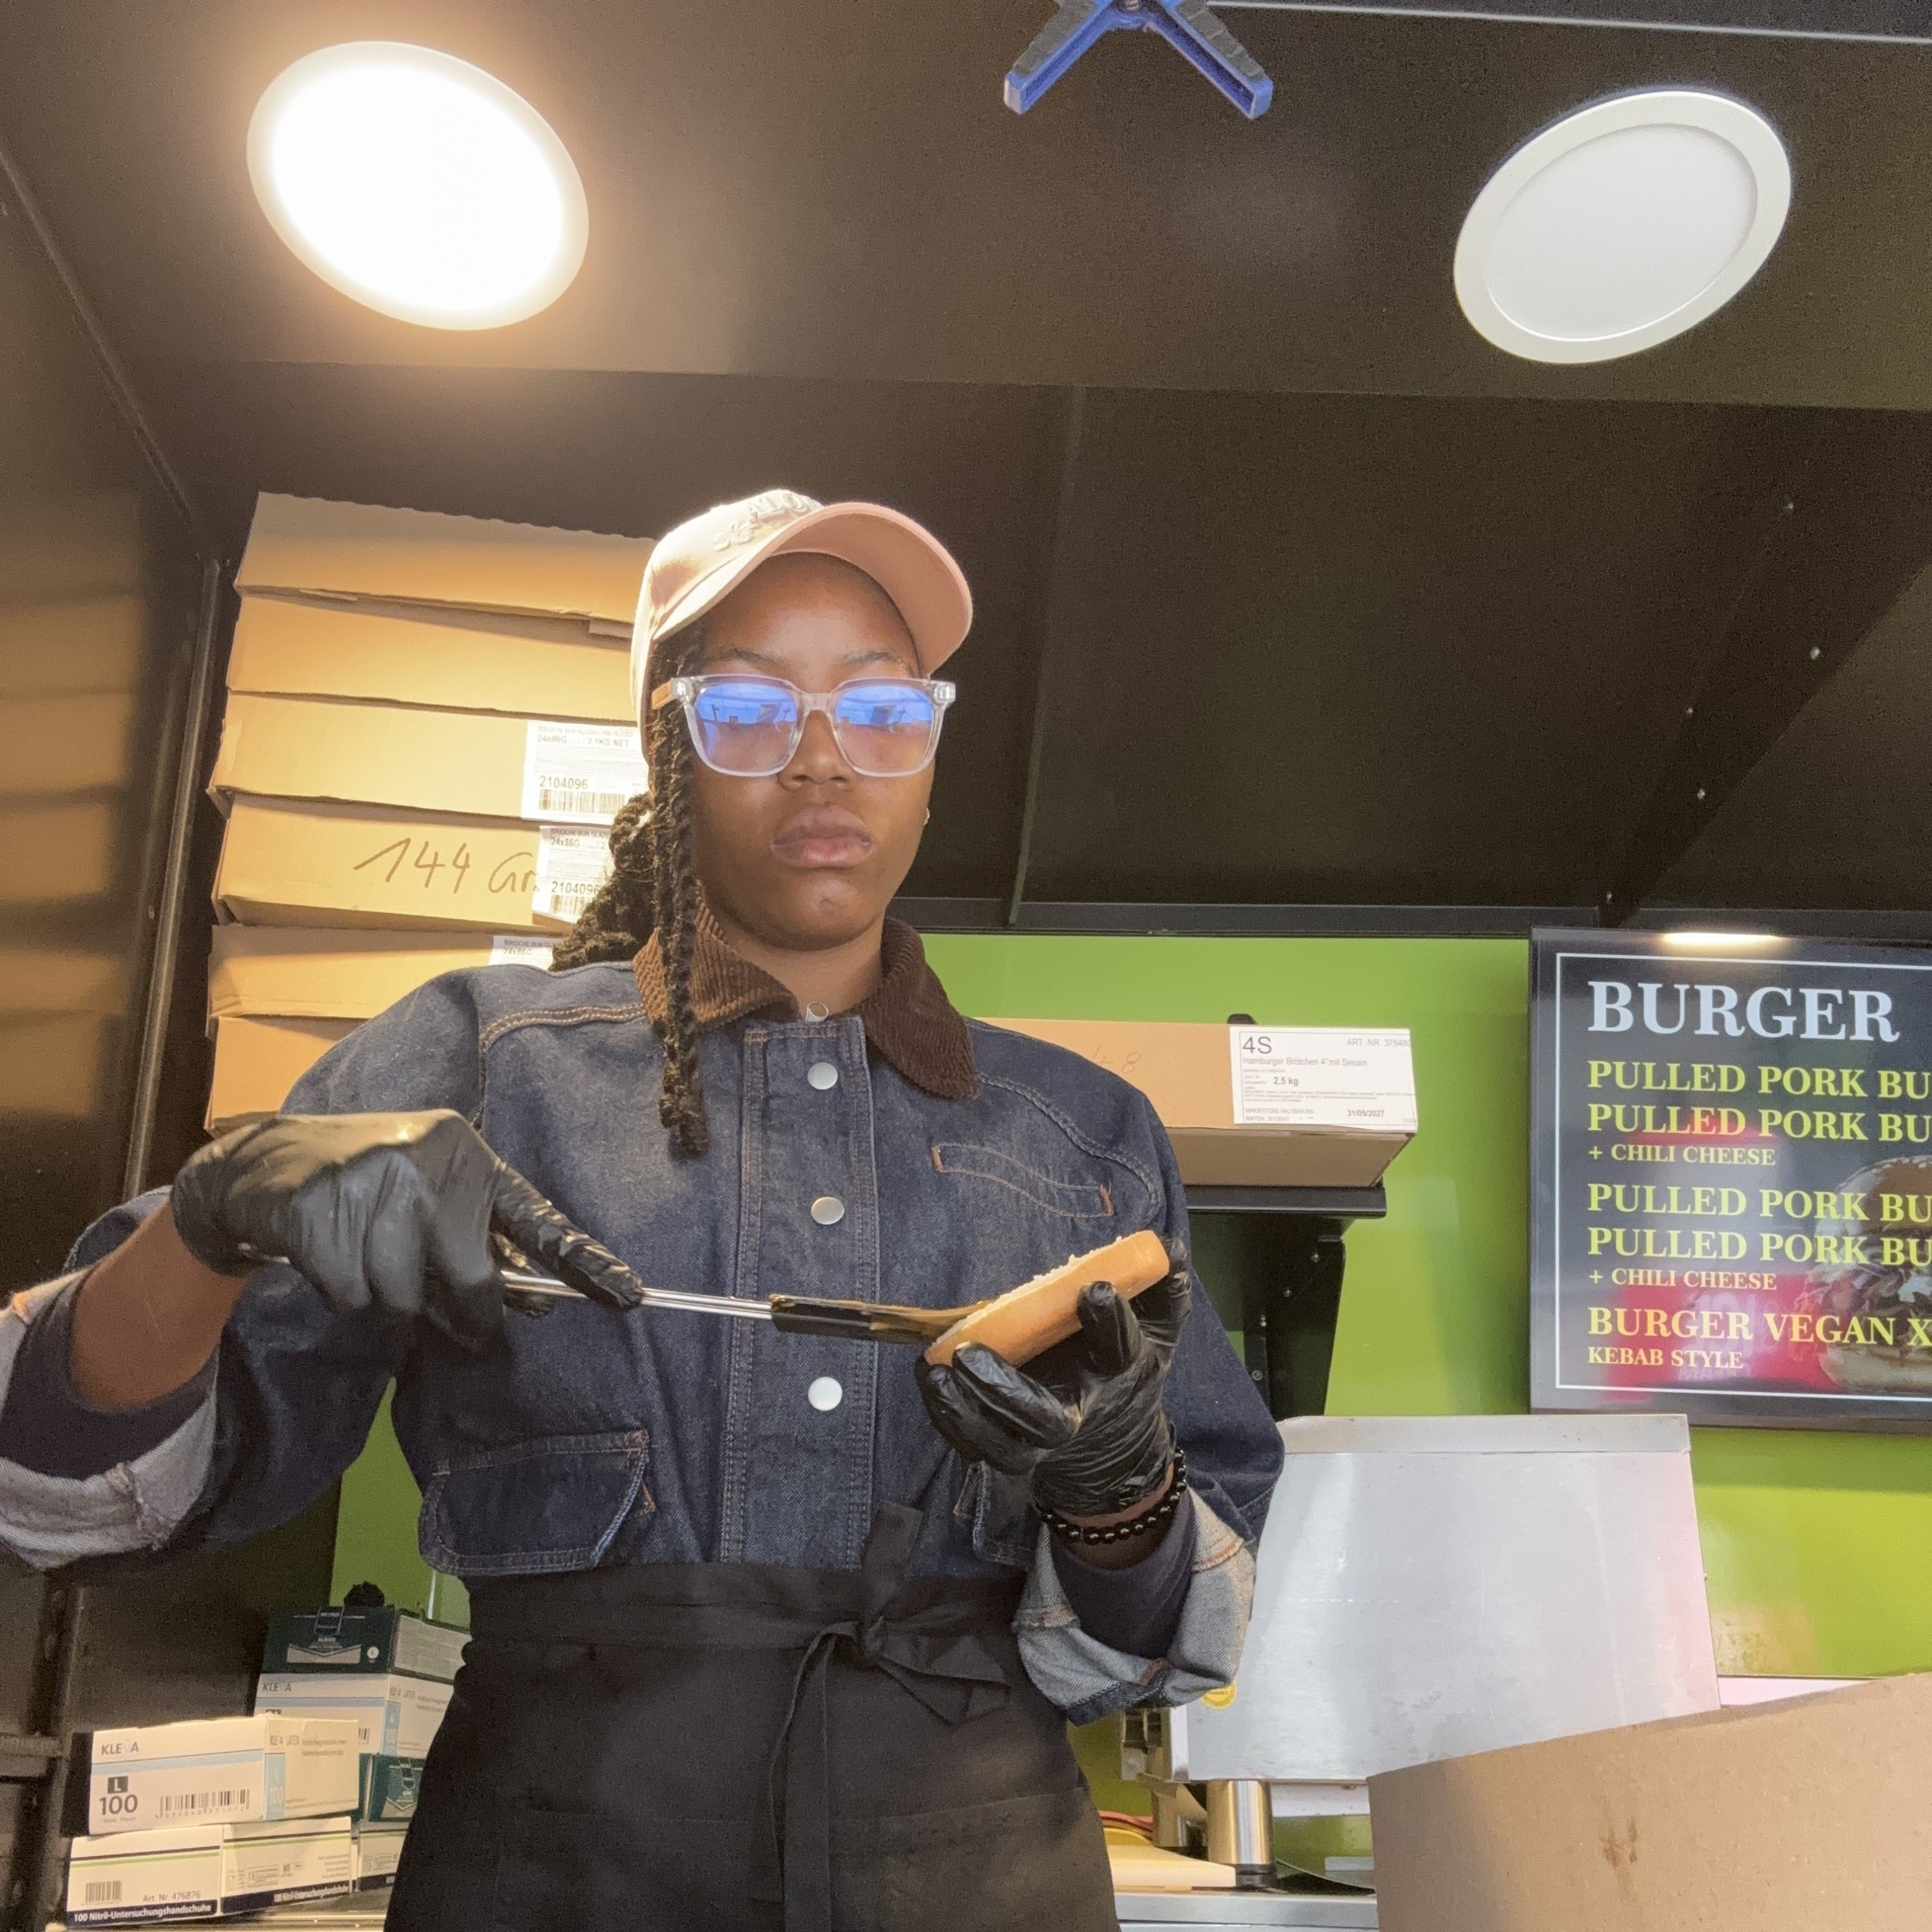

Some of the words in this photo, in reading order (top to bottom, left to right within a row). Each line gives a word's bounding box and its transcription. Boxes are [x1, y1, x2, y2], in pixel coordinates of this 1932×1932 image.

[539, 775, 589, 790] 2104096
[353, 837, 471, 895] 144
[551, 880, 599, 896] 2104096
[1587, 980, 1900, 1043] BURGER
[1242, 1036, 1273, 1054] 4S
[1243, 1057, 1284, 1067] Hamburger
[1286, 1057, 1319, 1066] Brötchen
[1342, 1058, 1367, 1066] Sesam
[1273, 1076, 1286, 1086] 2,5
[1289, 1077, 1299, 1087] kg
[1586, 1059, 1746, 1094] PULLED
[1757, 1065, 1868, 1097] PORK
[1347, 1109, 1385, 1117] 31/05/2027
[1586, 1103, 1747, 1137] PULLED
[1758, 1108, 1869, 1141] PORK
[1610, 1144, 1676, 1164] CHILI
[1682, 1146, 1776, 1166] CHEESE
[1586, 1183, 1747, 1217] PULLED
[1759, 1188, 1870, 1221] PORK
[1586, 1227, 1748, 1261] PULLED
[1759, 1232, 1870, 1265] PORK
[1610, 1267, 1677, 1288] CHILI
[1683, 1270, 1777, 1291] CHEESE
[1587, 1306, 1754, 1341] BURGER
[1763, 1312, 1896, 1346] VEGAN
[1587, 1346, 1664, 1367] KEBAB
[1671, 1349, 1744, 1369] STYLE
[114, 1778, 122, 1792] L
[99, 1793, 138, 1816] 100
[171, 1890, 201, 1901] 476876
[73, 1913, 88, 1922] 100
[89, 1903, 212, 1921] Nitril-Untersuchungshandschuhe
